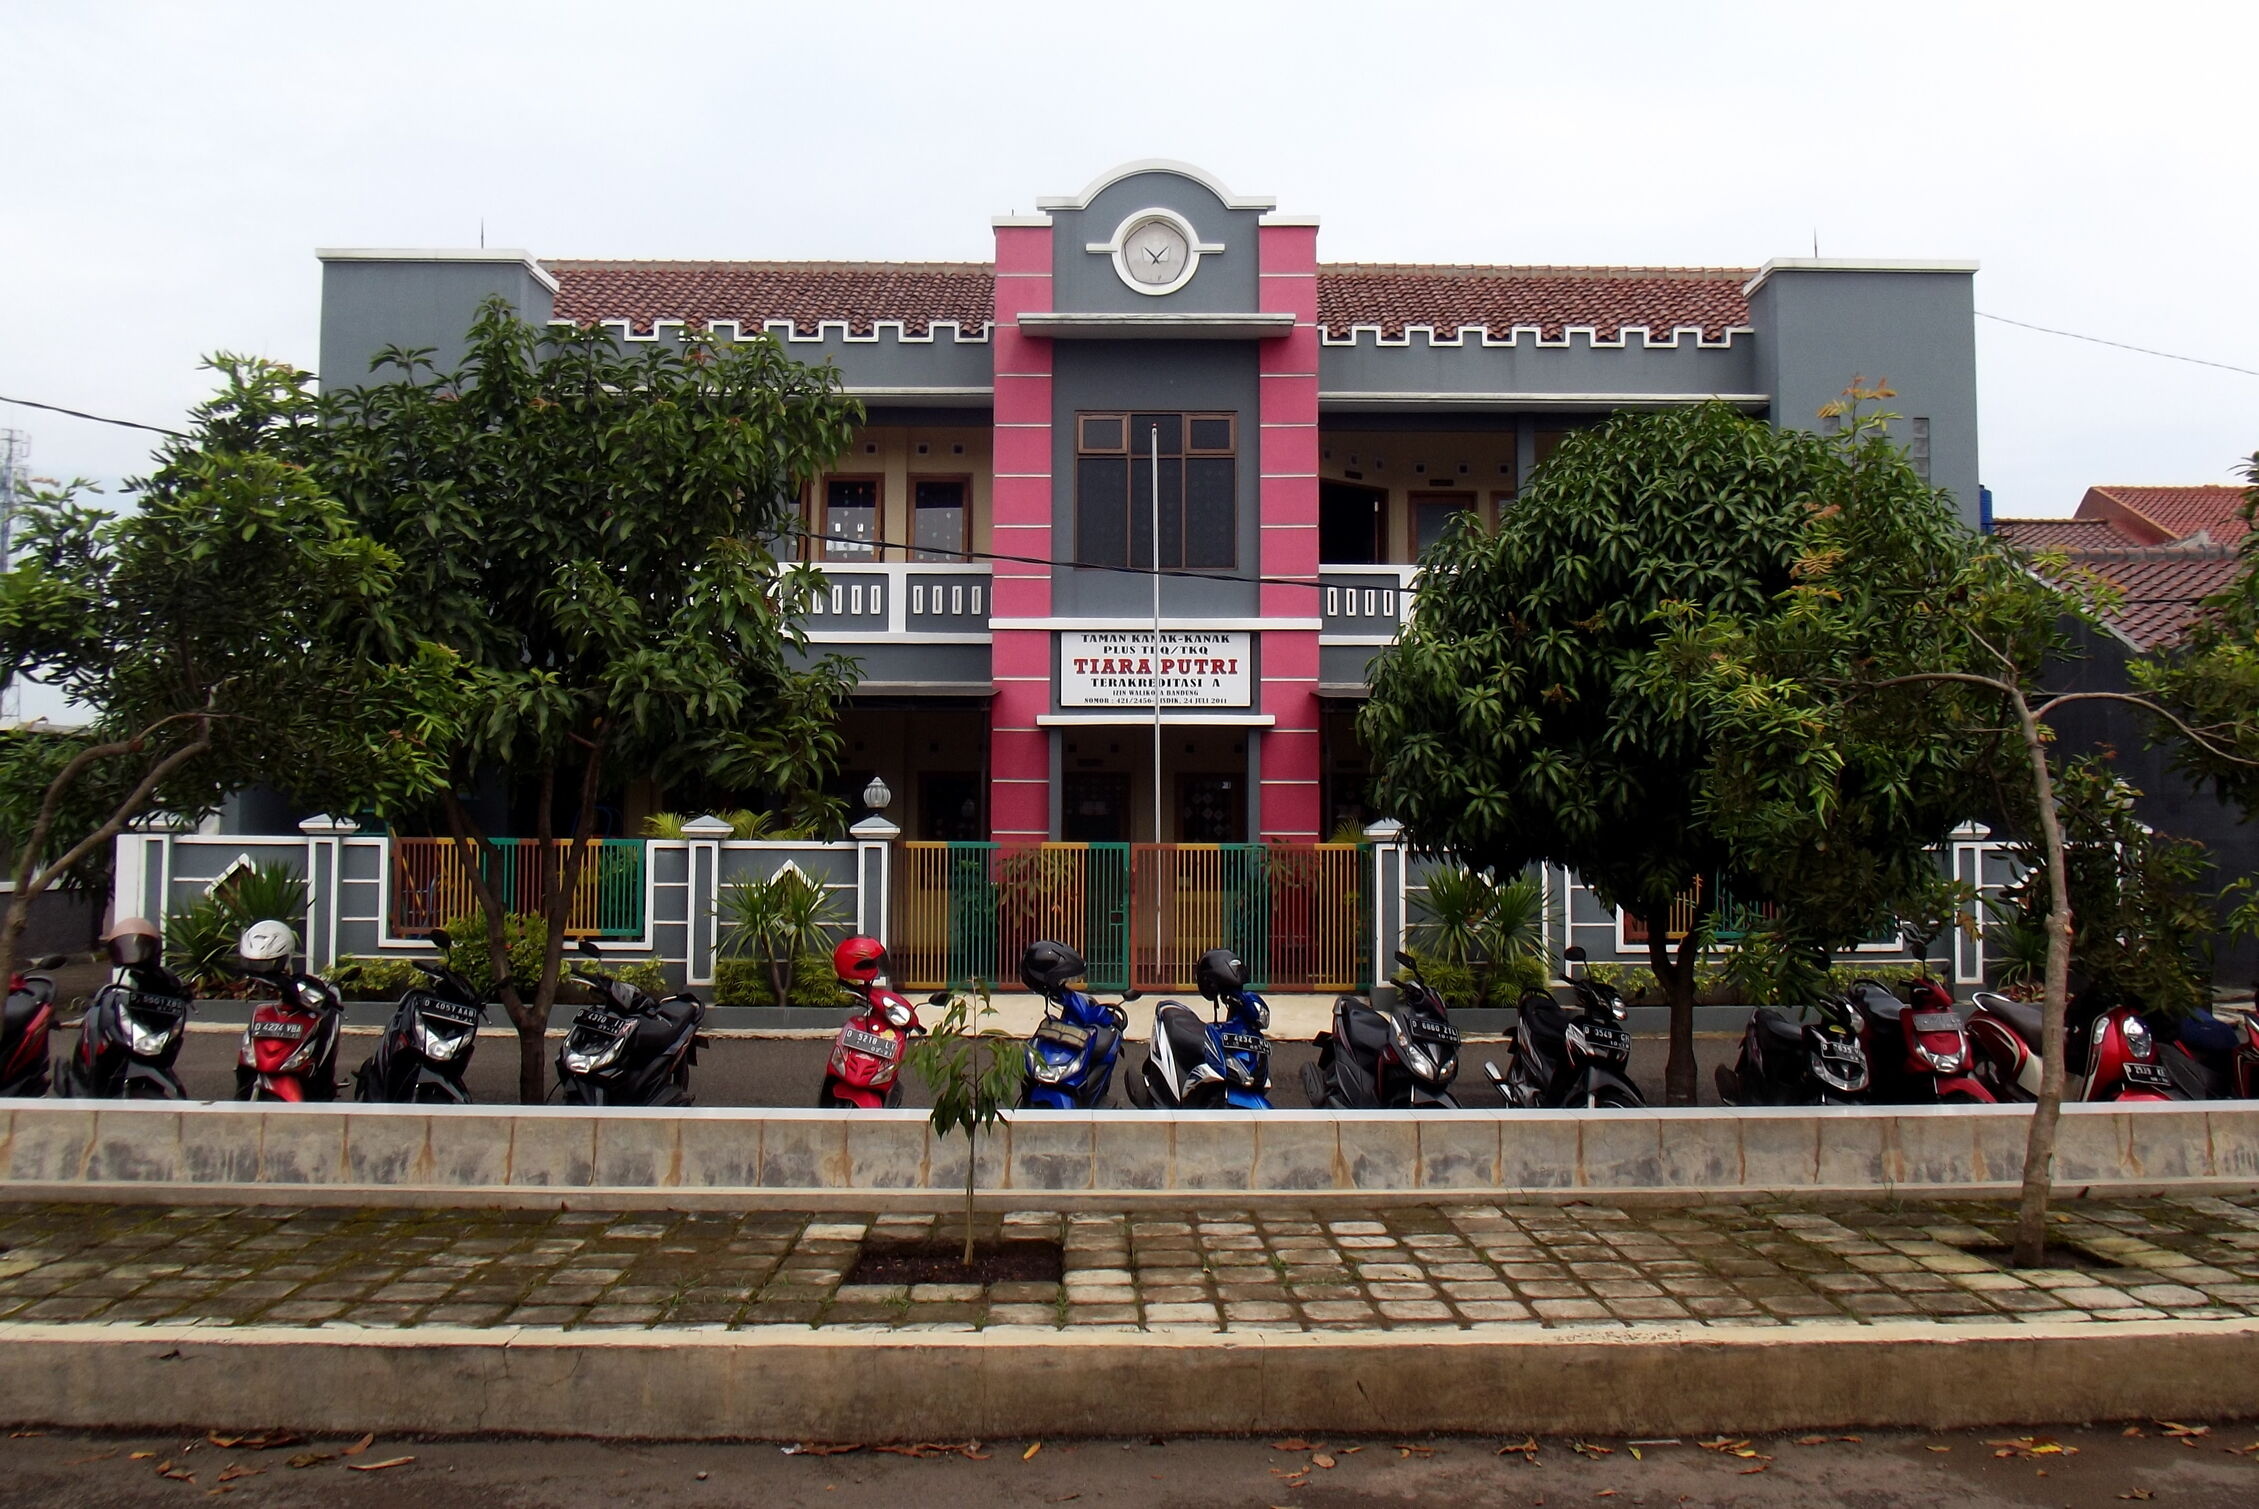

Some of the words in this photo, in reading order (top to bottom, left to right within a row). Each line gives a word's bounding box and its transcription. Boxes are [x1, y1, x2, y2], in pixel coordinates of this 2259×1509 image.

[1081, 634, 1126, 643] TAMAN
[1103, 646, 1136, 654] PLUS
[1073, 658, 1153, 675] TIARA
[1160, 658, 1238, 675] PUTRI
[1091, 678, 1202, 687] TERAKREDITASI
[1212, 678, 1221, 687] A
[424, 999, 431, 1007] D
[254, 1022, 262, 1031] D
[1584, 1026, 1590, 1034] D
[846, 1029, 853, 1038] D
